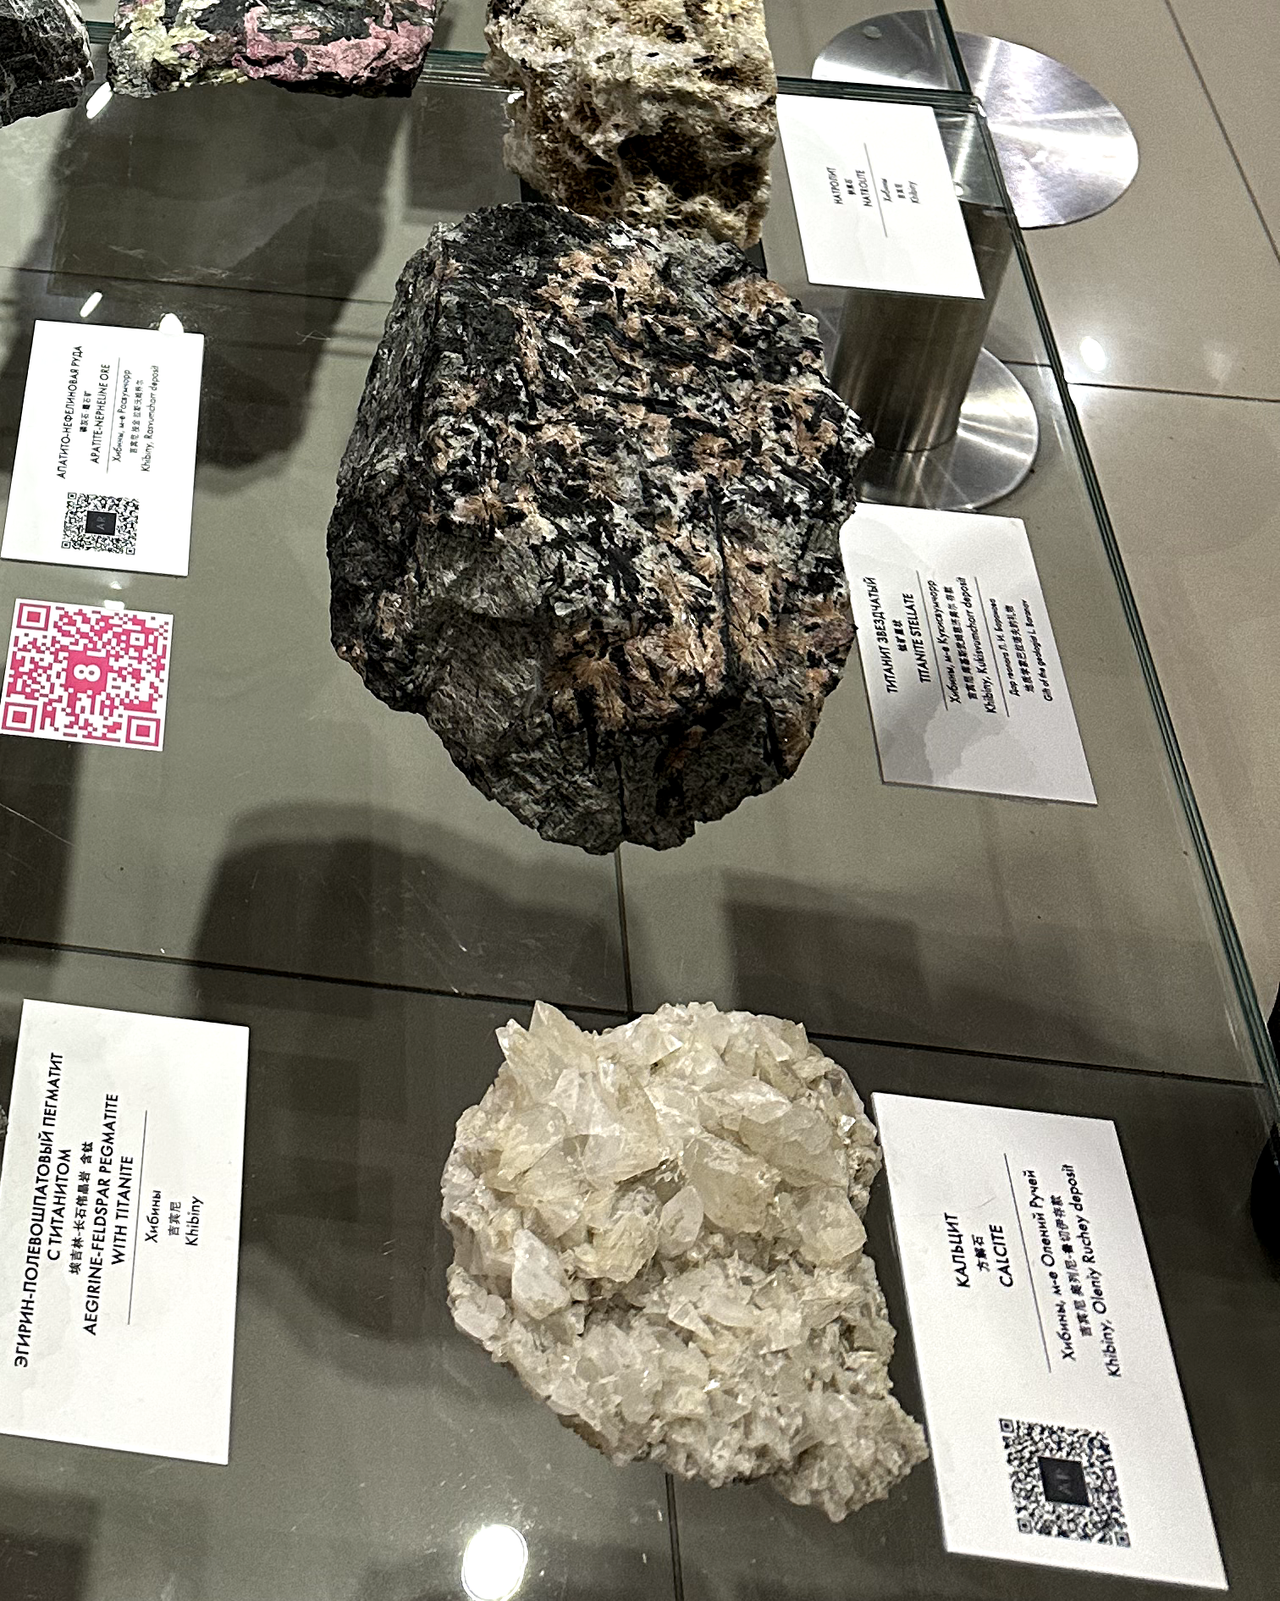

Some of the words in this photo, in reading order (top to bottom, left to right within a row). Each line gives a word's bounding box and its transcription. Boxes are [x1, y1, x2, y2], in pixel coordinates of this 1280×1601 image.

[856, 170, 872, 206] NATROLITE
[57, 369, 79, 479] АПАТИТО-НЕФЕЛИНОВАЯ
[71, 346, 83, 366] РУДА
[91, 383, 108, 464] APATITE-NEPHELINE
[100, 365, 110, 380] ORE
[96, 516, 106, 531] AR
[863, 577, 889, 644] ЗВЕЗДЧАТЫЙ
[902, 593, 922, 637] STELLATE
[956, 577, 972, 608] deposit
[912, 639, 933, 684] TITANITE
[966, 610, 988, 674] Kukisvumchorr
[879, 647, 899, 693] ТИТАНИТ
[982, 676, 997, 714] Khibiny,
[14, 1131, 54, 1367] ЭГИРИН-ПОЛЕВОШПАТОВЫЙ
[43, 1052, 63, 1126] ПЕГМАТИТ
[48, 1150, 71, 1245] ТИТАНИТОМ
[116, 1156, 133, 1220] TITANITE
[1022, 1170, 1044, 1208] Ручей
[1061, 1164, 1083, 1211] deposit
[83, 1179, 110, 1336] AEGIRINE-FELDSPAR
[99, 1094, 118, 1173] PEGMATITE
[145, 1190, 161, 1243] Хибины
[185, 1196, 204, 1246] Khibiny
[1032, 1213, 1055, 1267] Олений
[1076, 1215, 1095, 1263] Ruchey
[47, 1249, 60, 1260] С
[111, 1225, 127, 1265] WITH
[944, 1212, 970, 1288] КАЛЬЦИТ
[989, 1224, 1013, 1287] CALCITE
[1049, 1271, 1062, 1296] м-е
[1086, 1268, 1107, 1314] Oleniy
[1055, 1300, 1076, 1361] Хибины,
[1101, 1320, 1121, 1377] Khibiny,
